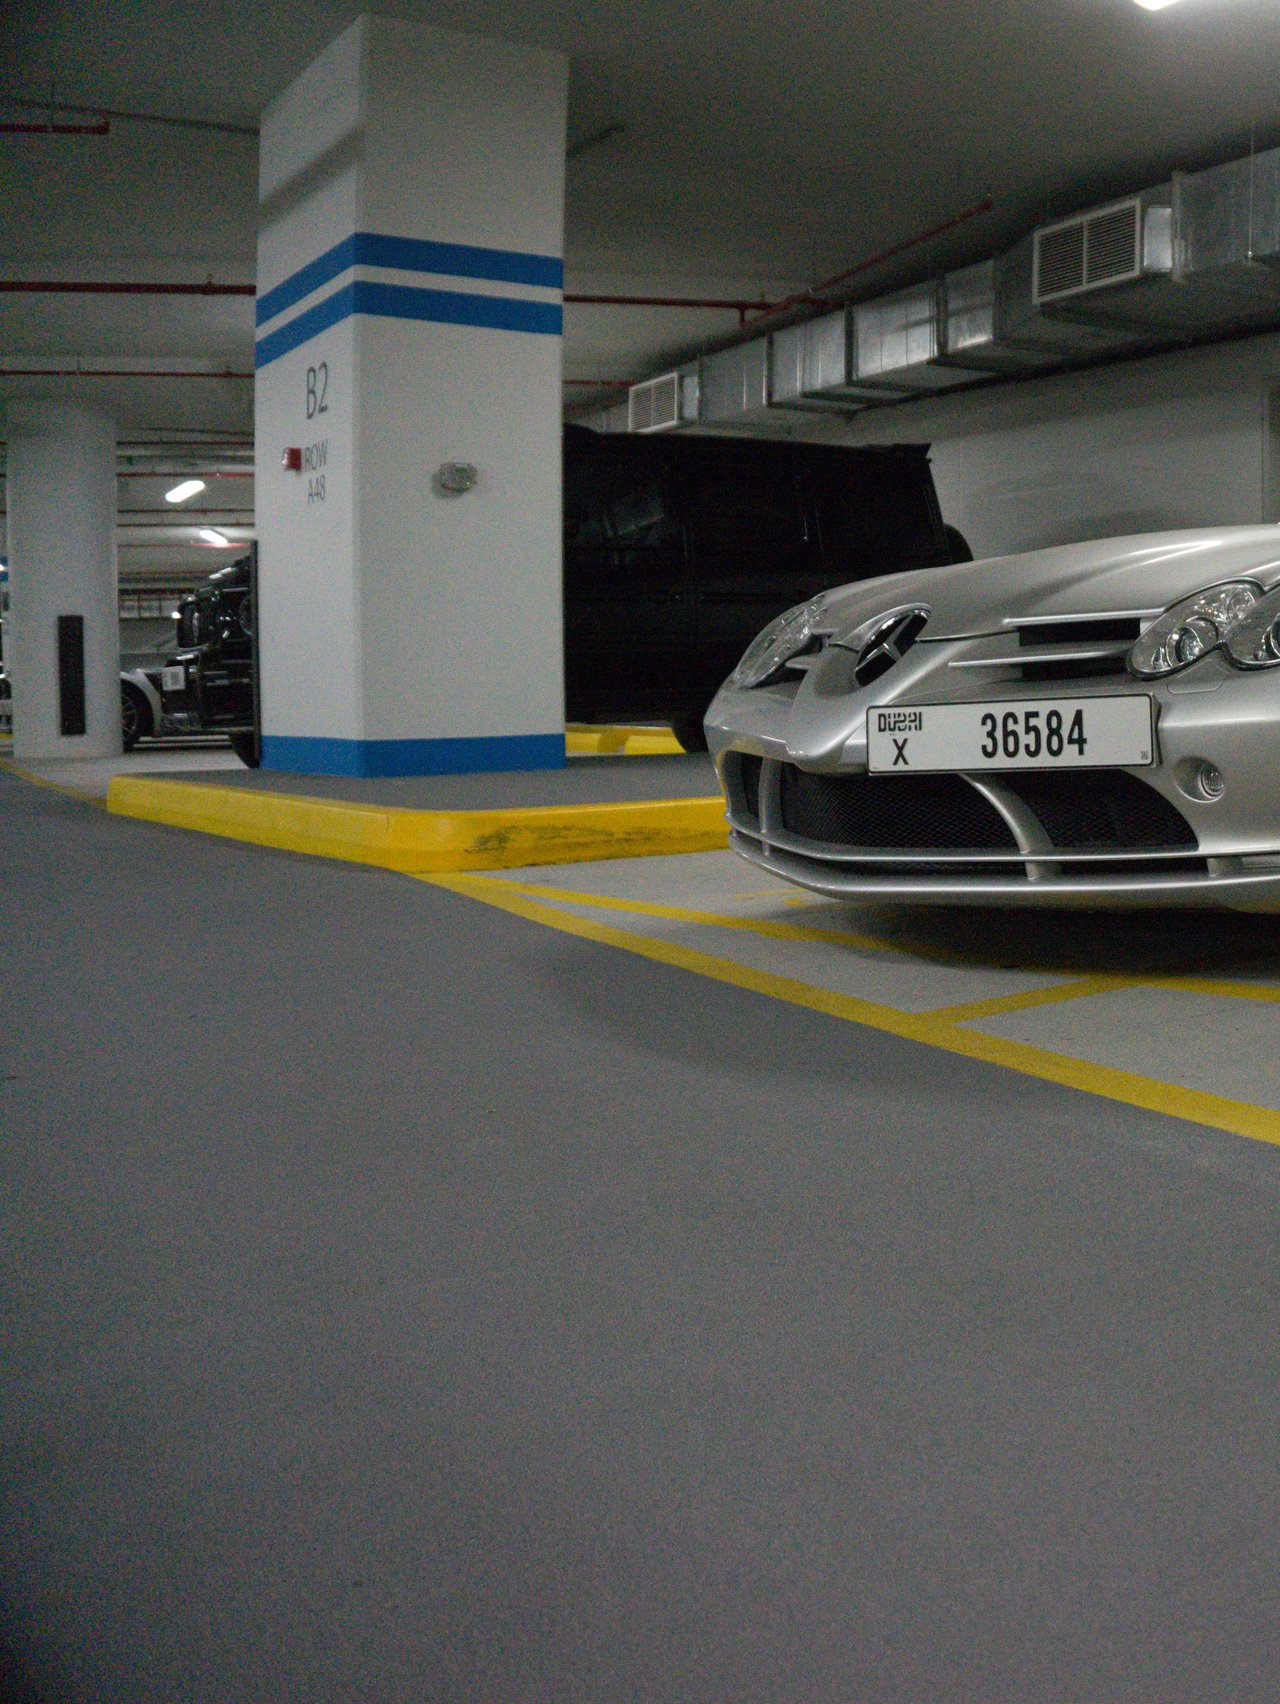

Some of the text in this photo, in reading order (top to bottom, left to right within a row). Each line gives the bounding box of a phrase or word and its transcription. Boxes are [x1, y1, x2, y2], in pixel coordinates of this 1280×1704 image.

[306, 361, 328, 419] B2
[304, 440, 328, 472] ROW
[307, 474, 325, 504] A48
[877, 711, 923, 733] DUBAI
[981, 708, 1088, 759] 36584
[892, 737, 909, 766] X
